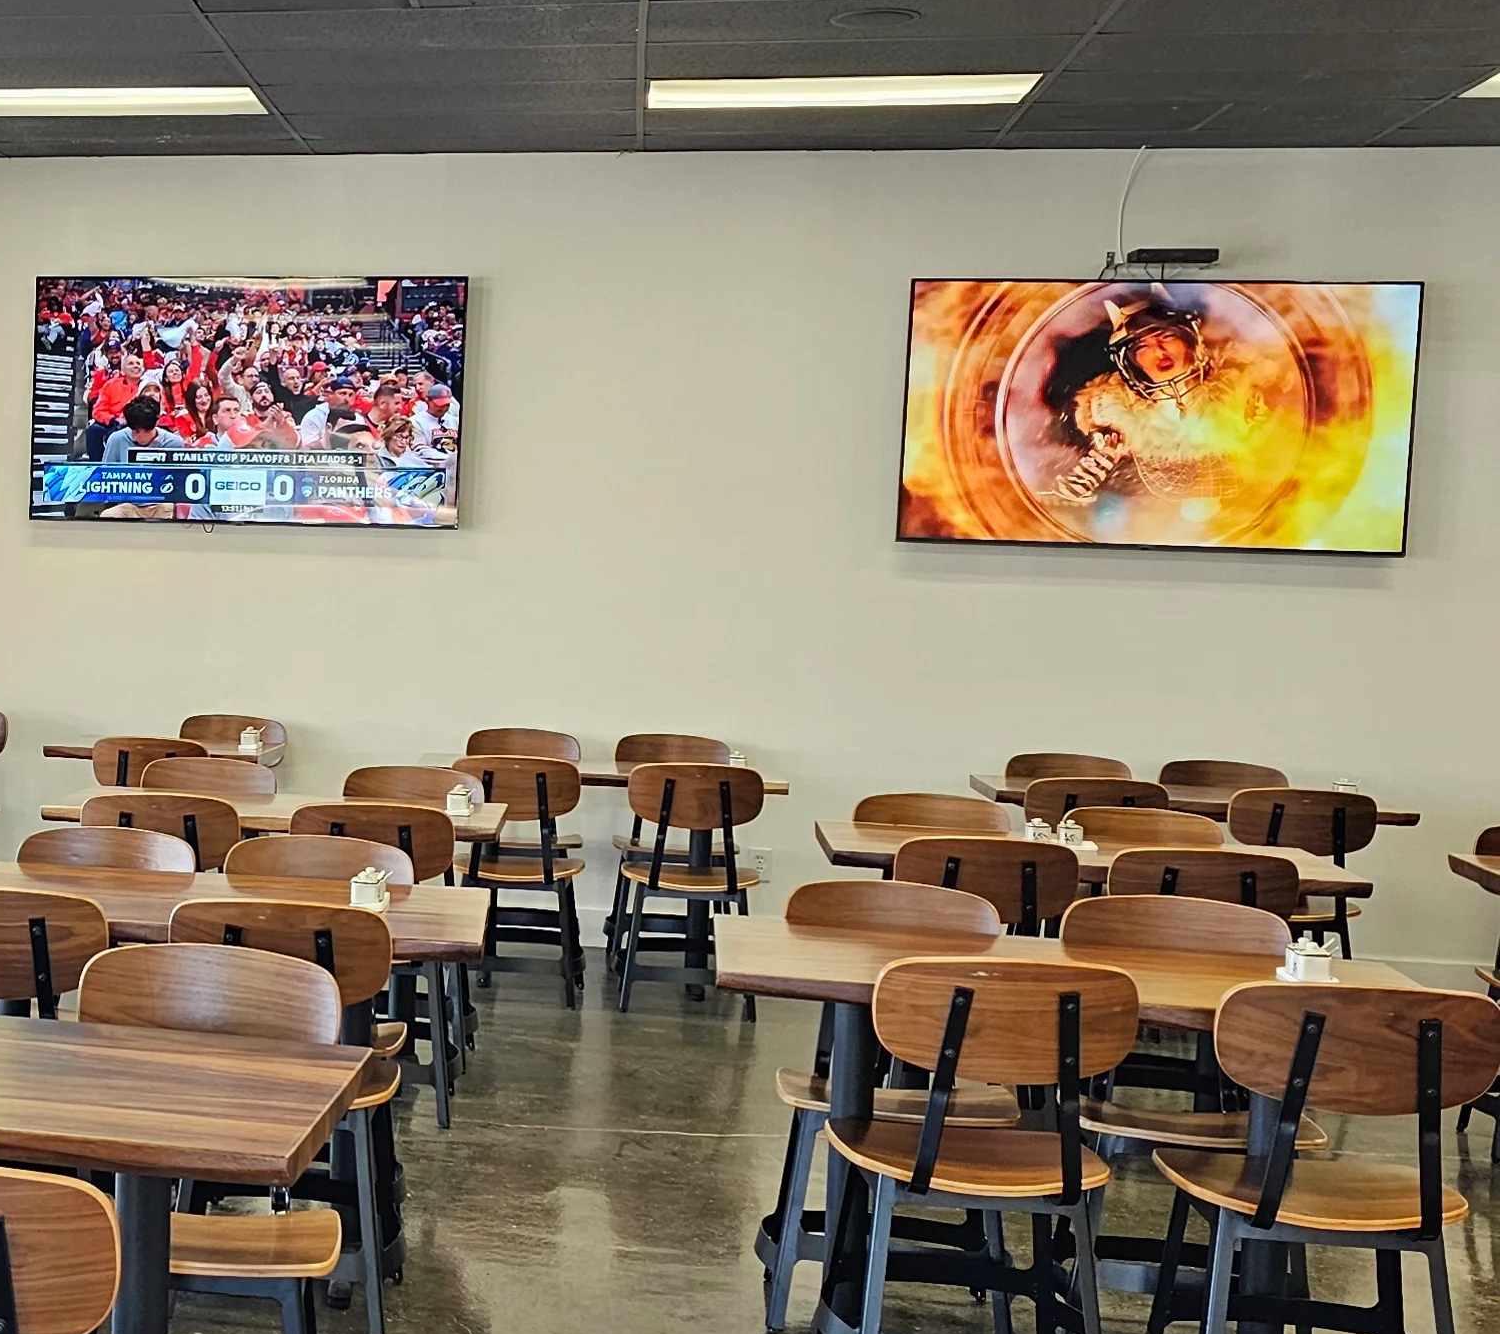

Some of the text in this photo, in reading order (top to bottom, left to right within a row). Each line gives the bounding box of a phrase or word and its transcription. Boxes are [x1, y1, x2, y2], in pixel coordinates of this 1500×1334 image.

[136, 452, 363, 465] ESPN STANLEY CUP PLAYOFFS FLA LEADS 2-1
[101, 471, 153, 481] TAMPA BAY
[319, 475, 360, 484] FLORIDA
[80, 481, 154, 494] LIGHTNING
[185, 473, 206, 501] 0
[215, 481, 261, 491] GEICO
[273, 474, 295, 502] 0
[318, 486, 393, 499] PANTHERS
